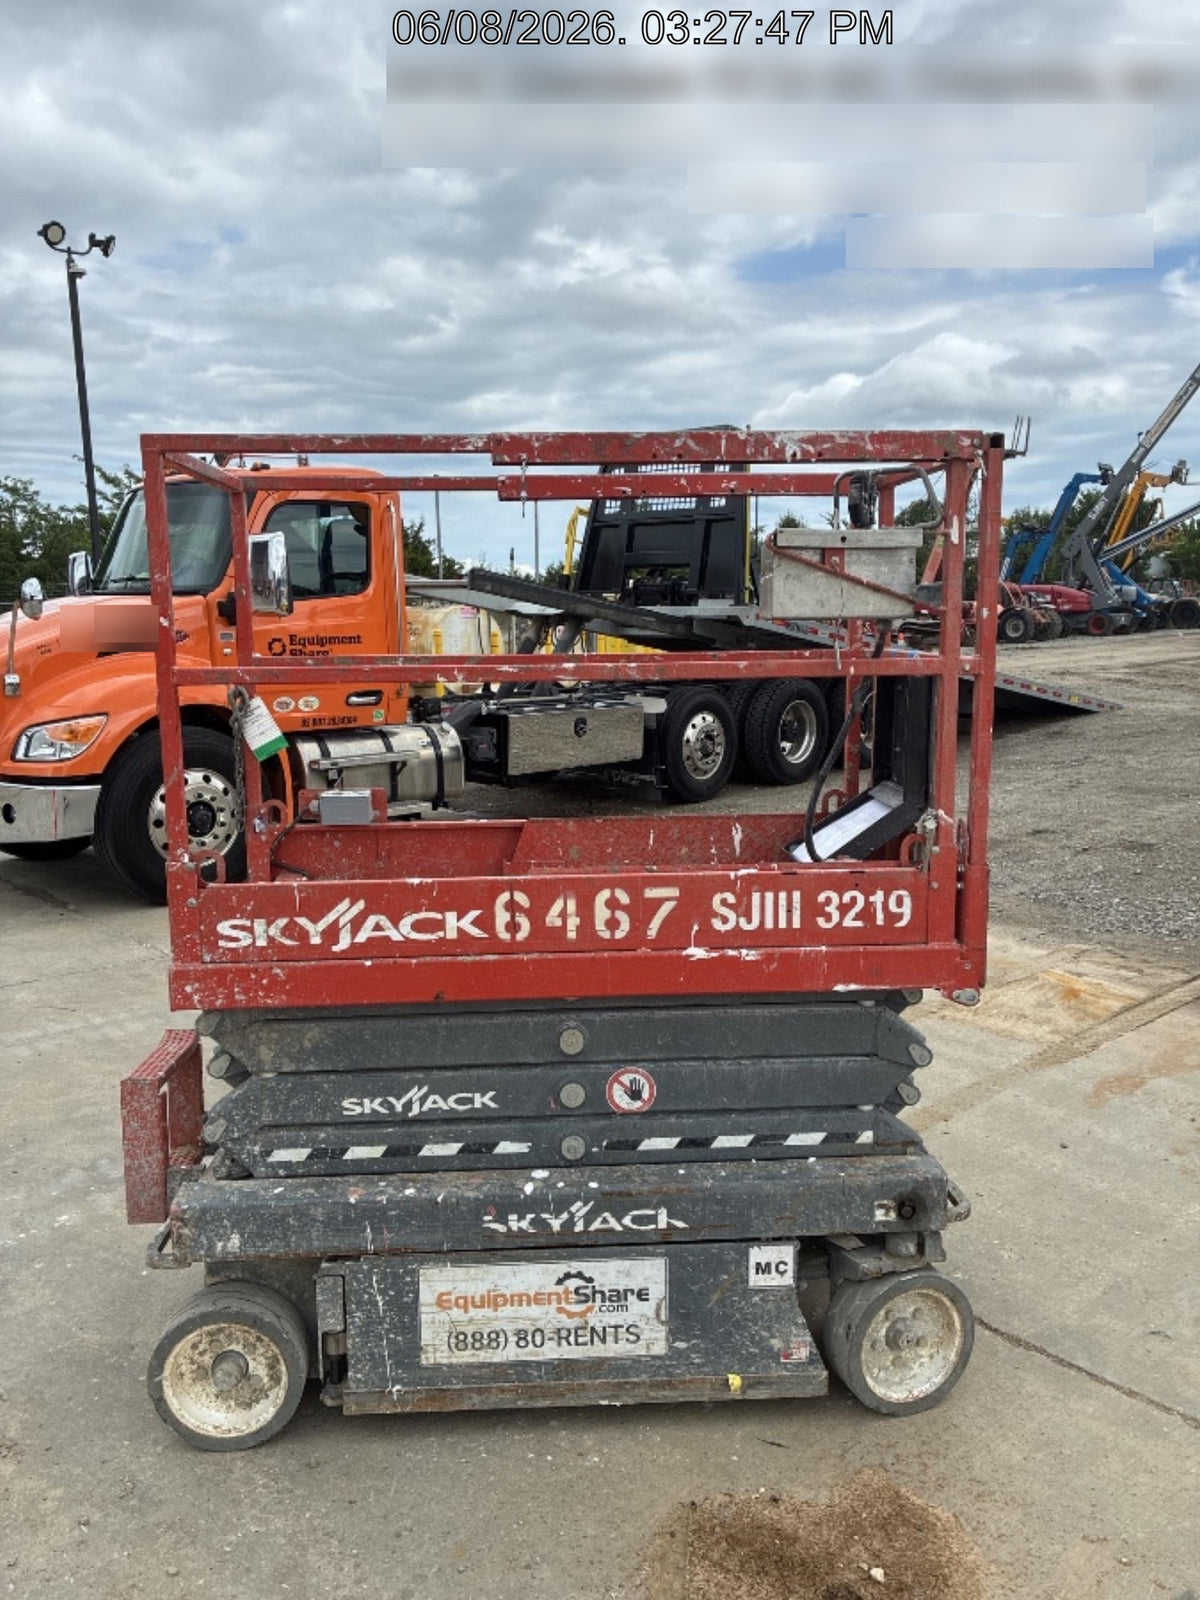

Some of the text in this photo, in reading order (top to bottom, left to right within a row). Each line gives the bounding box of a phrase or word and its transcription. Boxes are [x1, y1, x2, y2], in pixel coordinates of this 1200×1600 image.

[288, 634, 362, 647] Equipment
[216, 897, 489, 952] SKYJACK
[494, 886, 680, 942] 6467
[711, 889, 912, 932] SJIII 3219
[342, 1084, 499, 1117] SKYJACK
[754, 1260, 789, 1276] MC
[435, 1285, 650, 1314] EquipmentShare
[447, 1324, 641, 1353] (888) 80-RENTS
